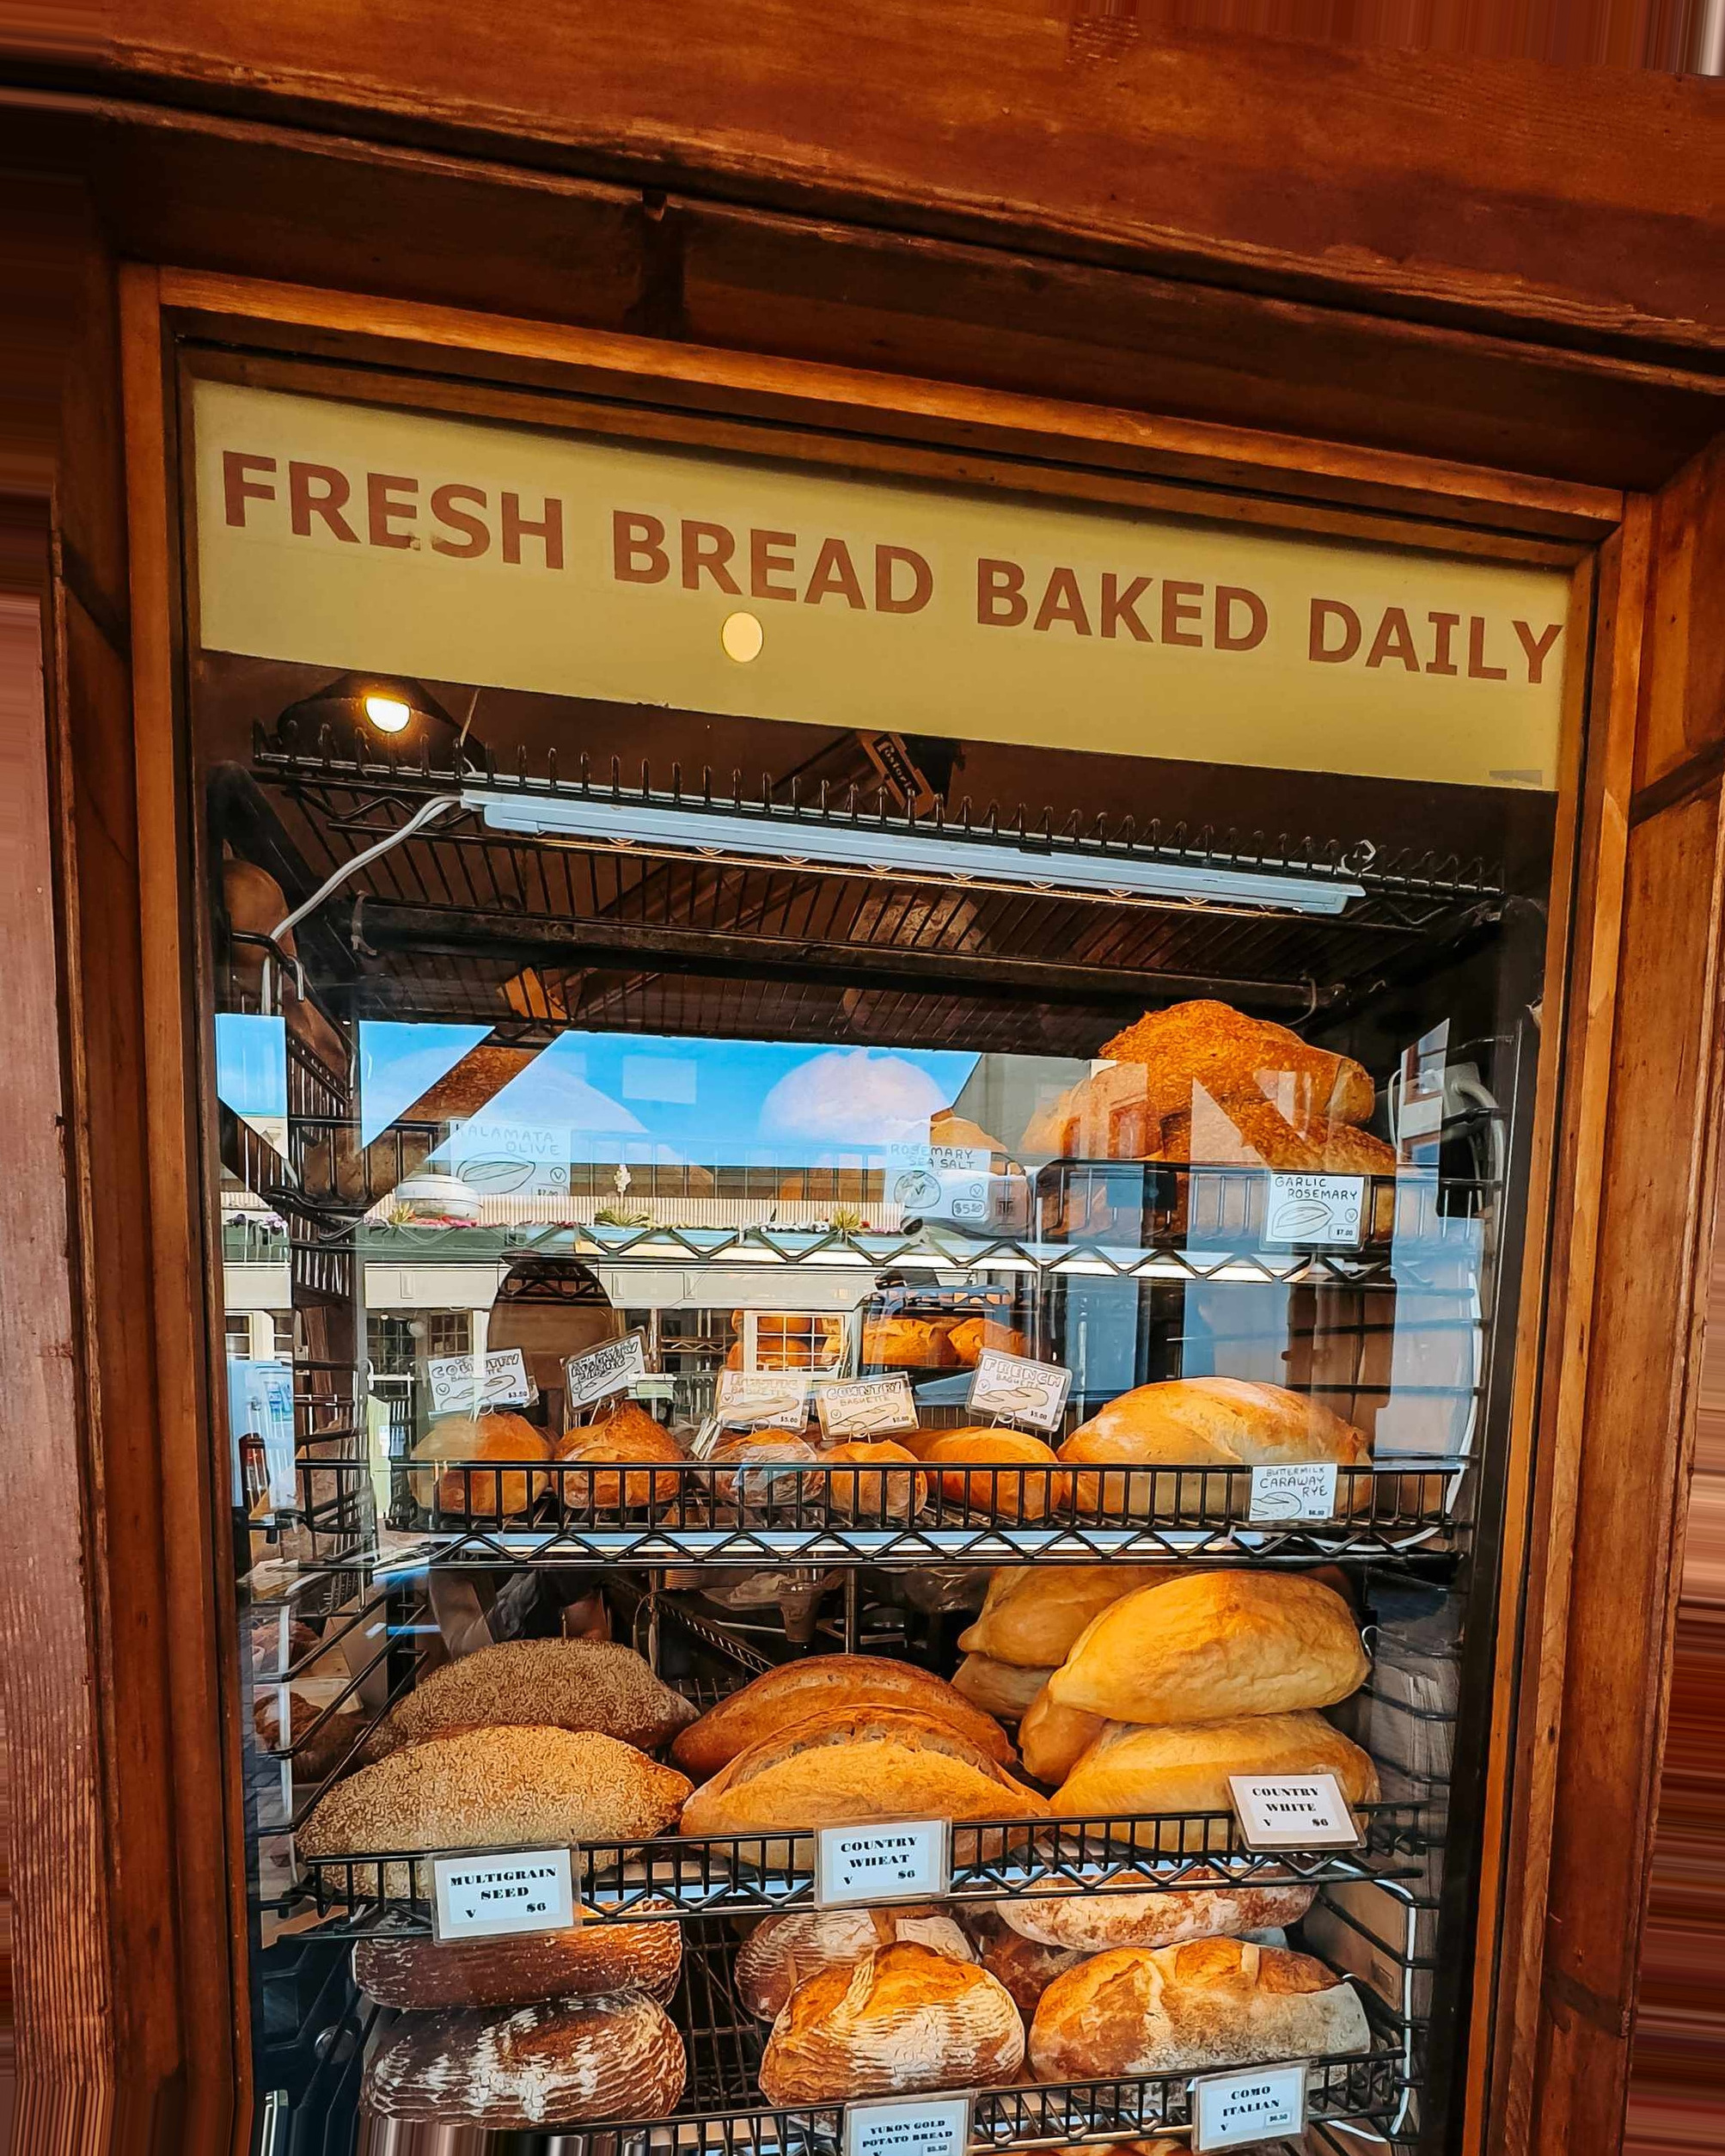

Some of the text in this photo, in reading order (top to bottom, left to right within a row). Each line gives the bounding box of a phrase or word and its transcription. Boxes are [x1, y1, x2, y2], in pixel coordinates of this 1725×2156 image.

[223, 450, 1563, 684] FRESH BREAD BAKED DAILY
[505, 1141, 560, 1155] OLIVE
[890, 1143, 973, 1160] ROSEMARY
[909, 1157, 976, 1169] SEA SALT
[1275, 1176, 1327, 1187] GARLIC
[1288, 1188, 1358, 1200] ROSEMARY
[983, 1358, 1062, 1387] FRENCH
[826, 1381, 902, 1400] COUNTRY
[1266, 1467, 1324, 1477] BUTTERMILK
[1259, 1476, 1325, 1489] CARAWAY
[1302, 1485, 1328, 1498] RYE
[1251, 1787, 1319, 1797] COUNTRY
[1265, 1803, 1317, 1812] WHITE
[1263, 1818, 1271, 1827] V
[840, 1836, 919, 1853] COUNTRY
[849, 1853, 910, 1869] WHEAT
[450, 1867, 557, 1887] MULTIGRAIN
[841, 1869, 916, 1886] V $6
[480, 1886, 529, 1901] SEED
[465, 1902, 547, 1919] V $6
[1231, 2086, 1271, 2100] COMO
[1222, 2098, 1281, 2117] ITALIAN
[870, 2120, 945, 2135] YUKON GOLD
[1220, 2122, 1229, 2132] V
[862, 2130, 953, 2148] POTATO BREAD
